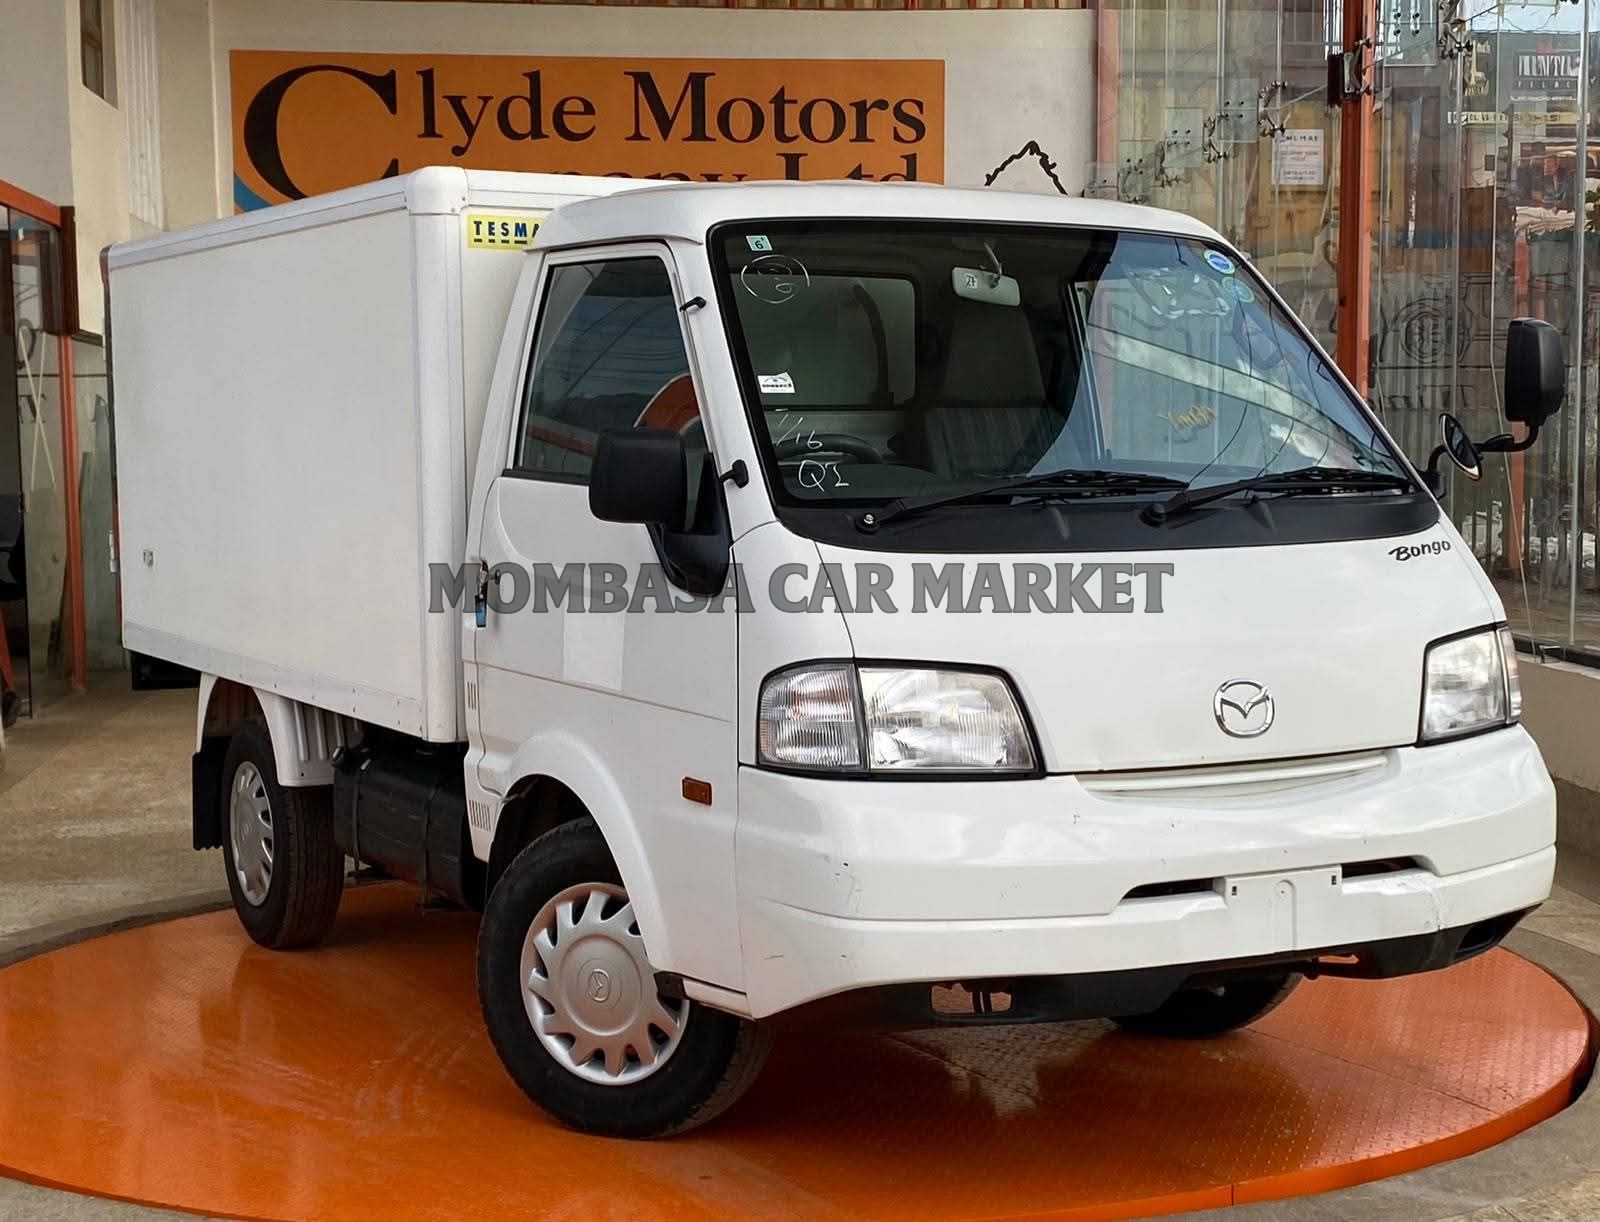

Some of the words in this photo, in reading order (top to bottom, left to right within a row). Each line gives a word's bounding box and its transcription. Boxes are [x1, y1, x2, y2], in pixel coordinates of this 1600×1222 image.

[243, 64, 596, 199] Clyde
[624, 71, 927, 144] Motors
[1388, 540, 1451, 561] Bongo
